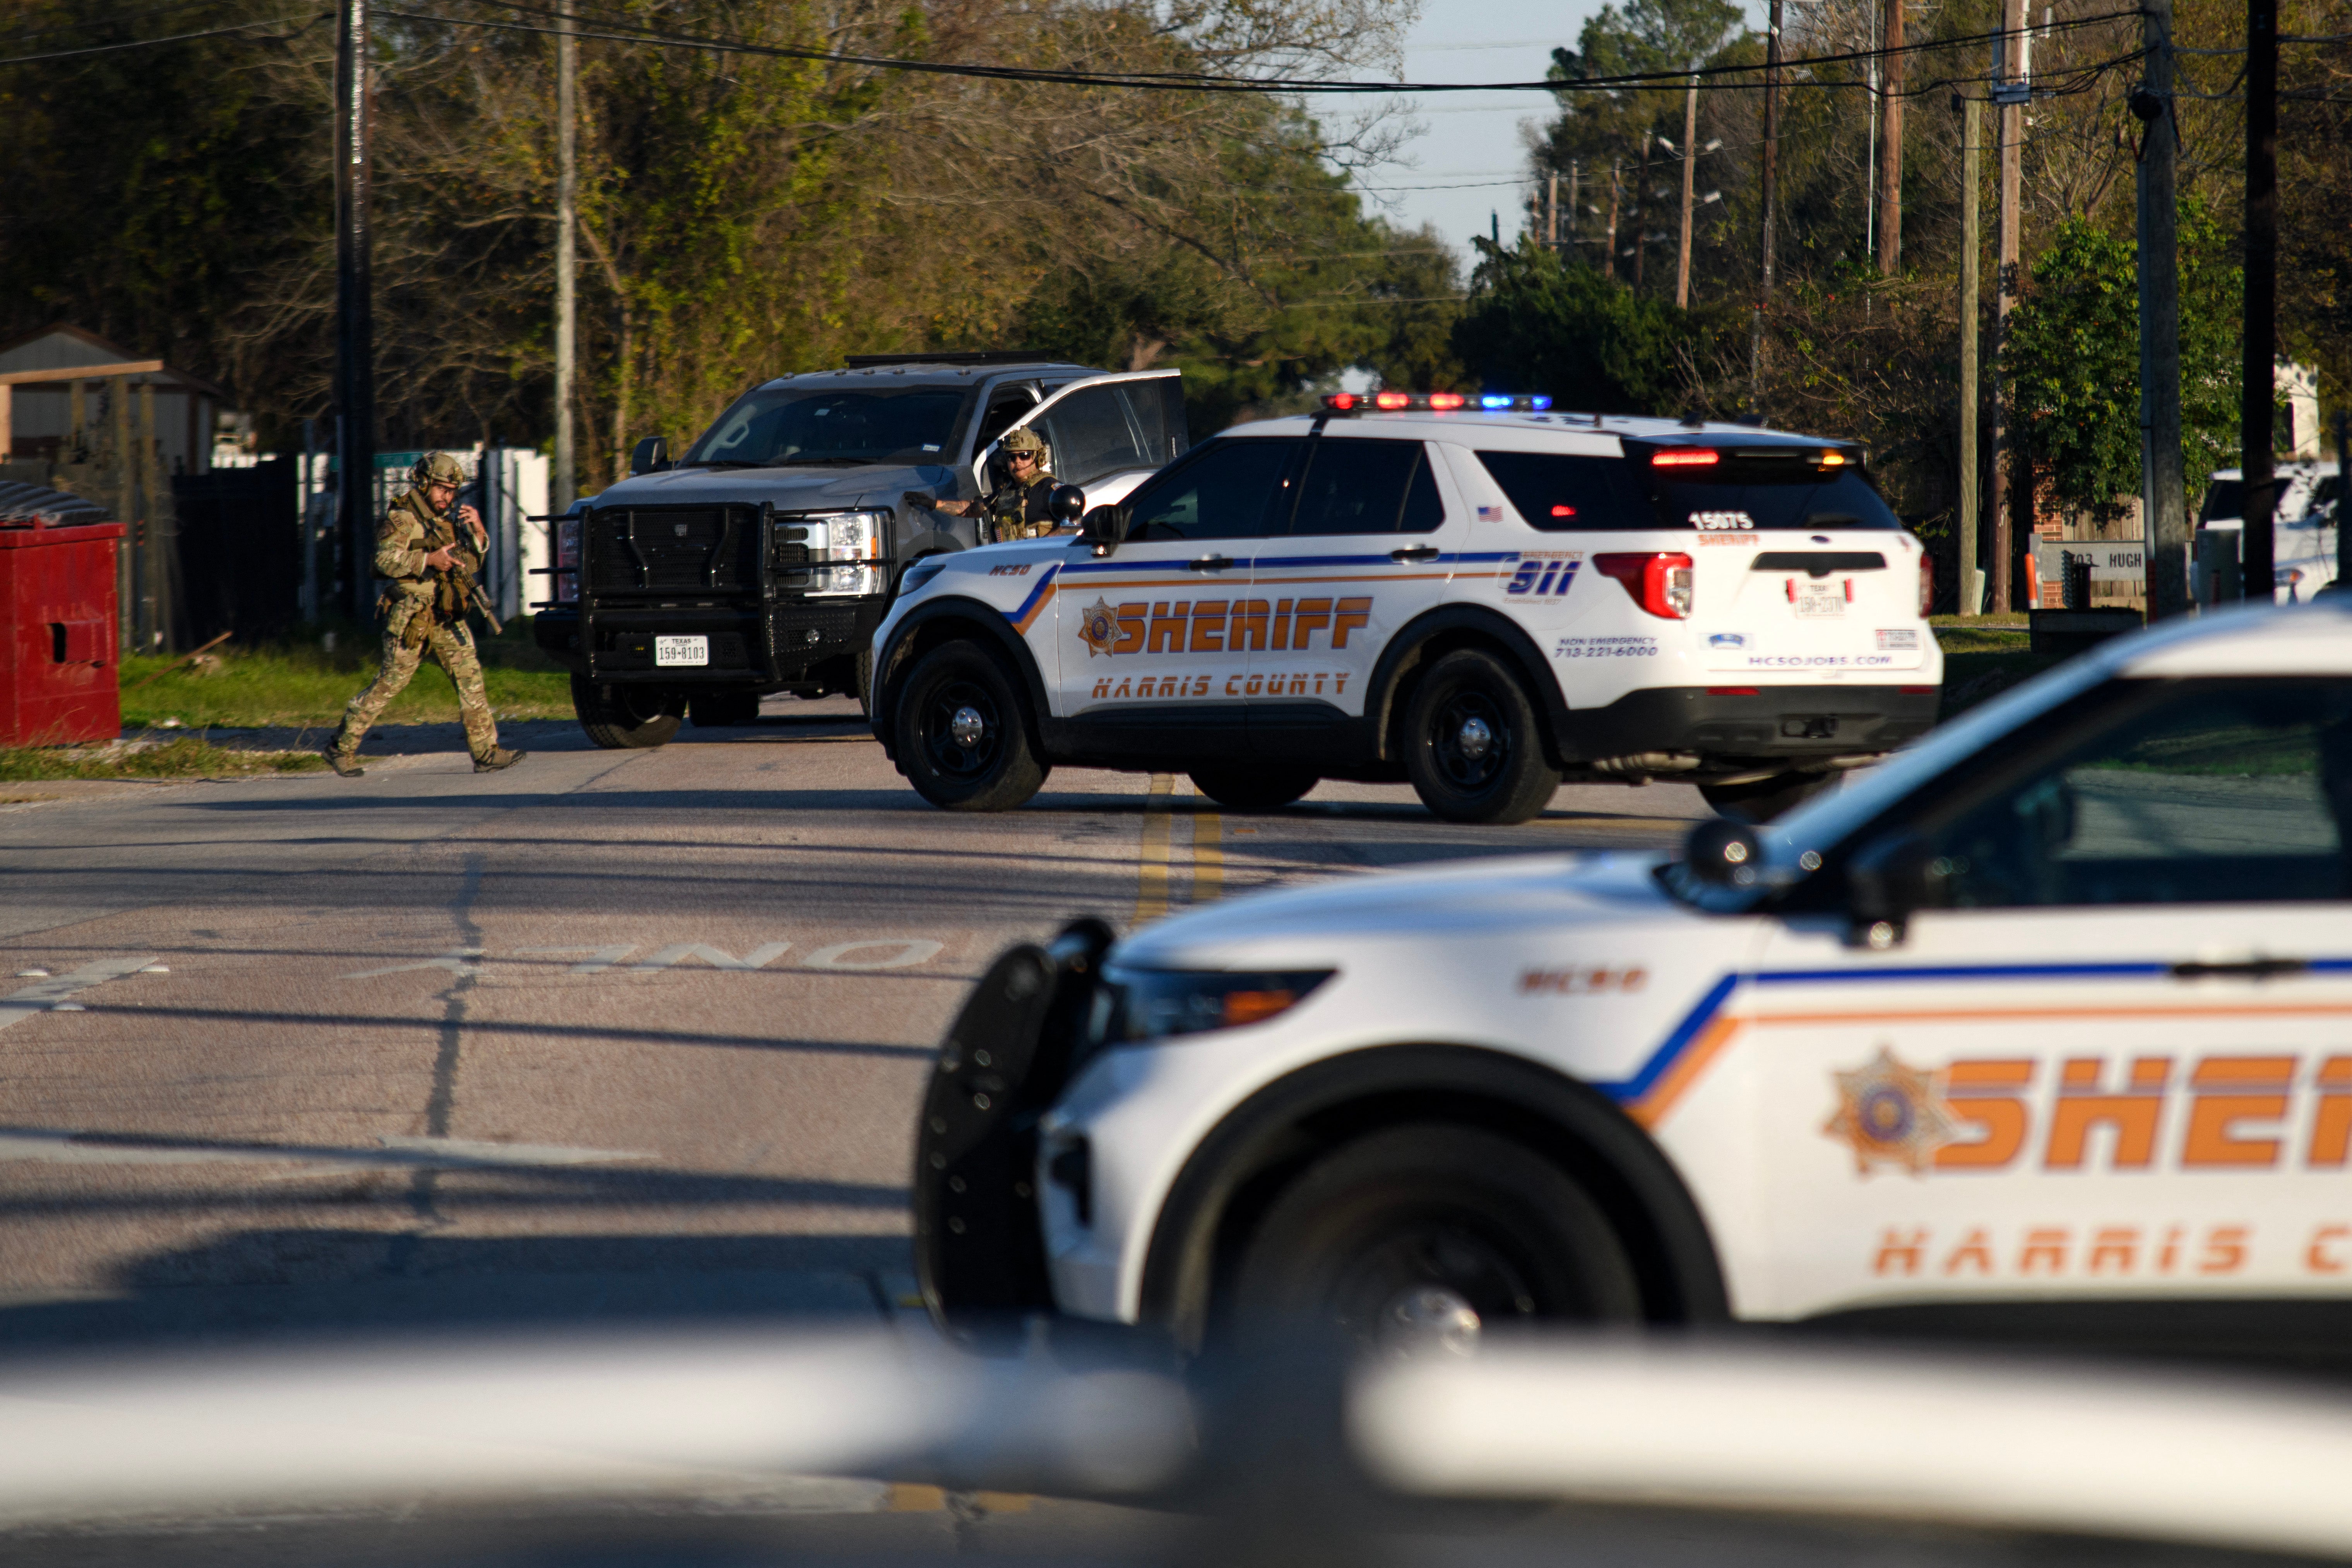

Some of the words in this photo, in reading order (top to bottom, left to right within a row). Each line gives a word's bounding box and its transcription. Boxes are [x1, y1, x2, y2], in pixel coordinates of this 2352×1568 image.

[1688, 510, 1754, 530] 15075
[1697, 534, 1759, 546] SHERIFF
[2071, 554, 2093, 564] 03
[2109, 553, 2141, 568] HUGH
[989, 564, 1032, 576] HCSO
[1507, 561, 1583, 596] 911
[1113, 597, 1374, 654] SHERIFF
[1554, 647, 1659, 658] 713-221-6000
[1748, 656, 1893, 666] HCSOJOBS.COM
[1091, 675, 1212, 699] HARRIS
[1225, 673, 1351, 697] COUNTY
[1871, 1222, 2252, 1278] HARRIS
